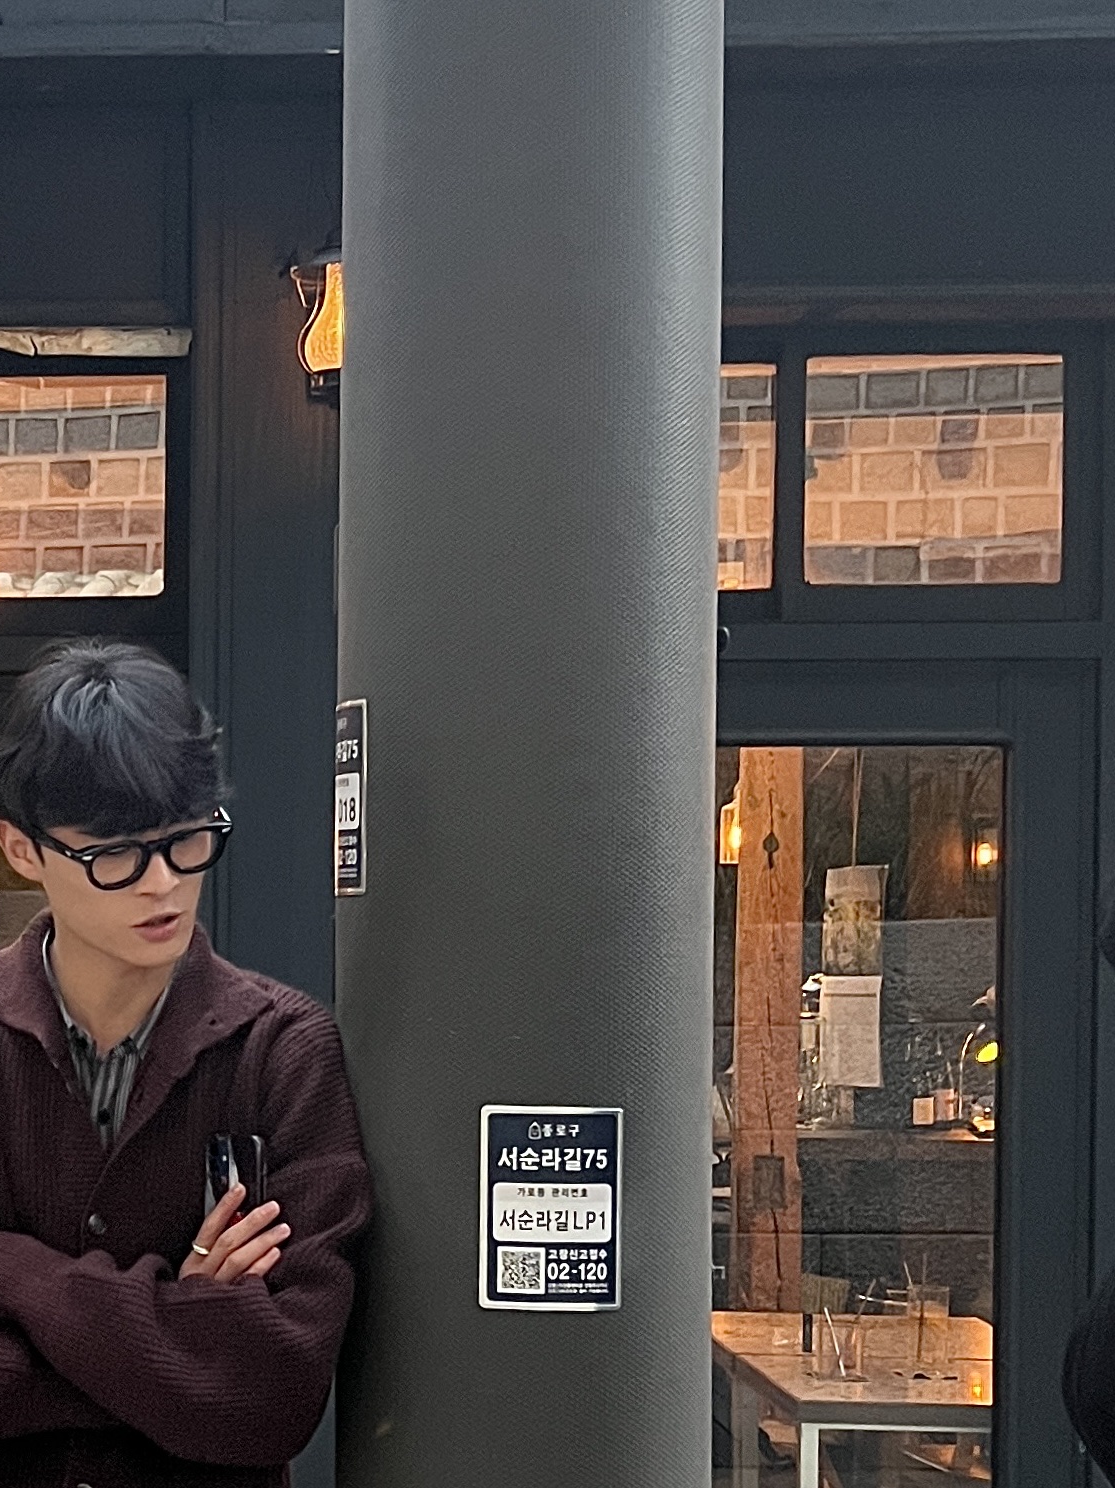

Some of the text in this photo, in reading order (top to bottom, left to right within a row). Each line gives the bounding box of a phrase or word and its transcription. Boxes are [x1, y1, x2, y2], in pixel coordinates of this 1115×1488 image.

[542, 1123, 580, 1138] 종로구
[498, 1147, 608, 1171] 서순라길75
[500, 1209, 606, 1232] 서순라길LP1
[547, 1262, 608, 1280] 02-120
